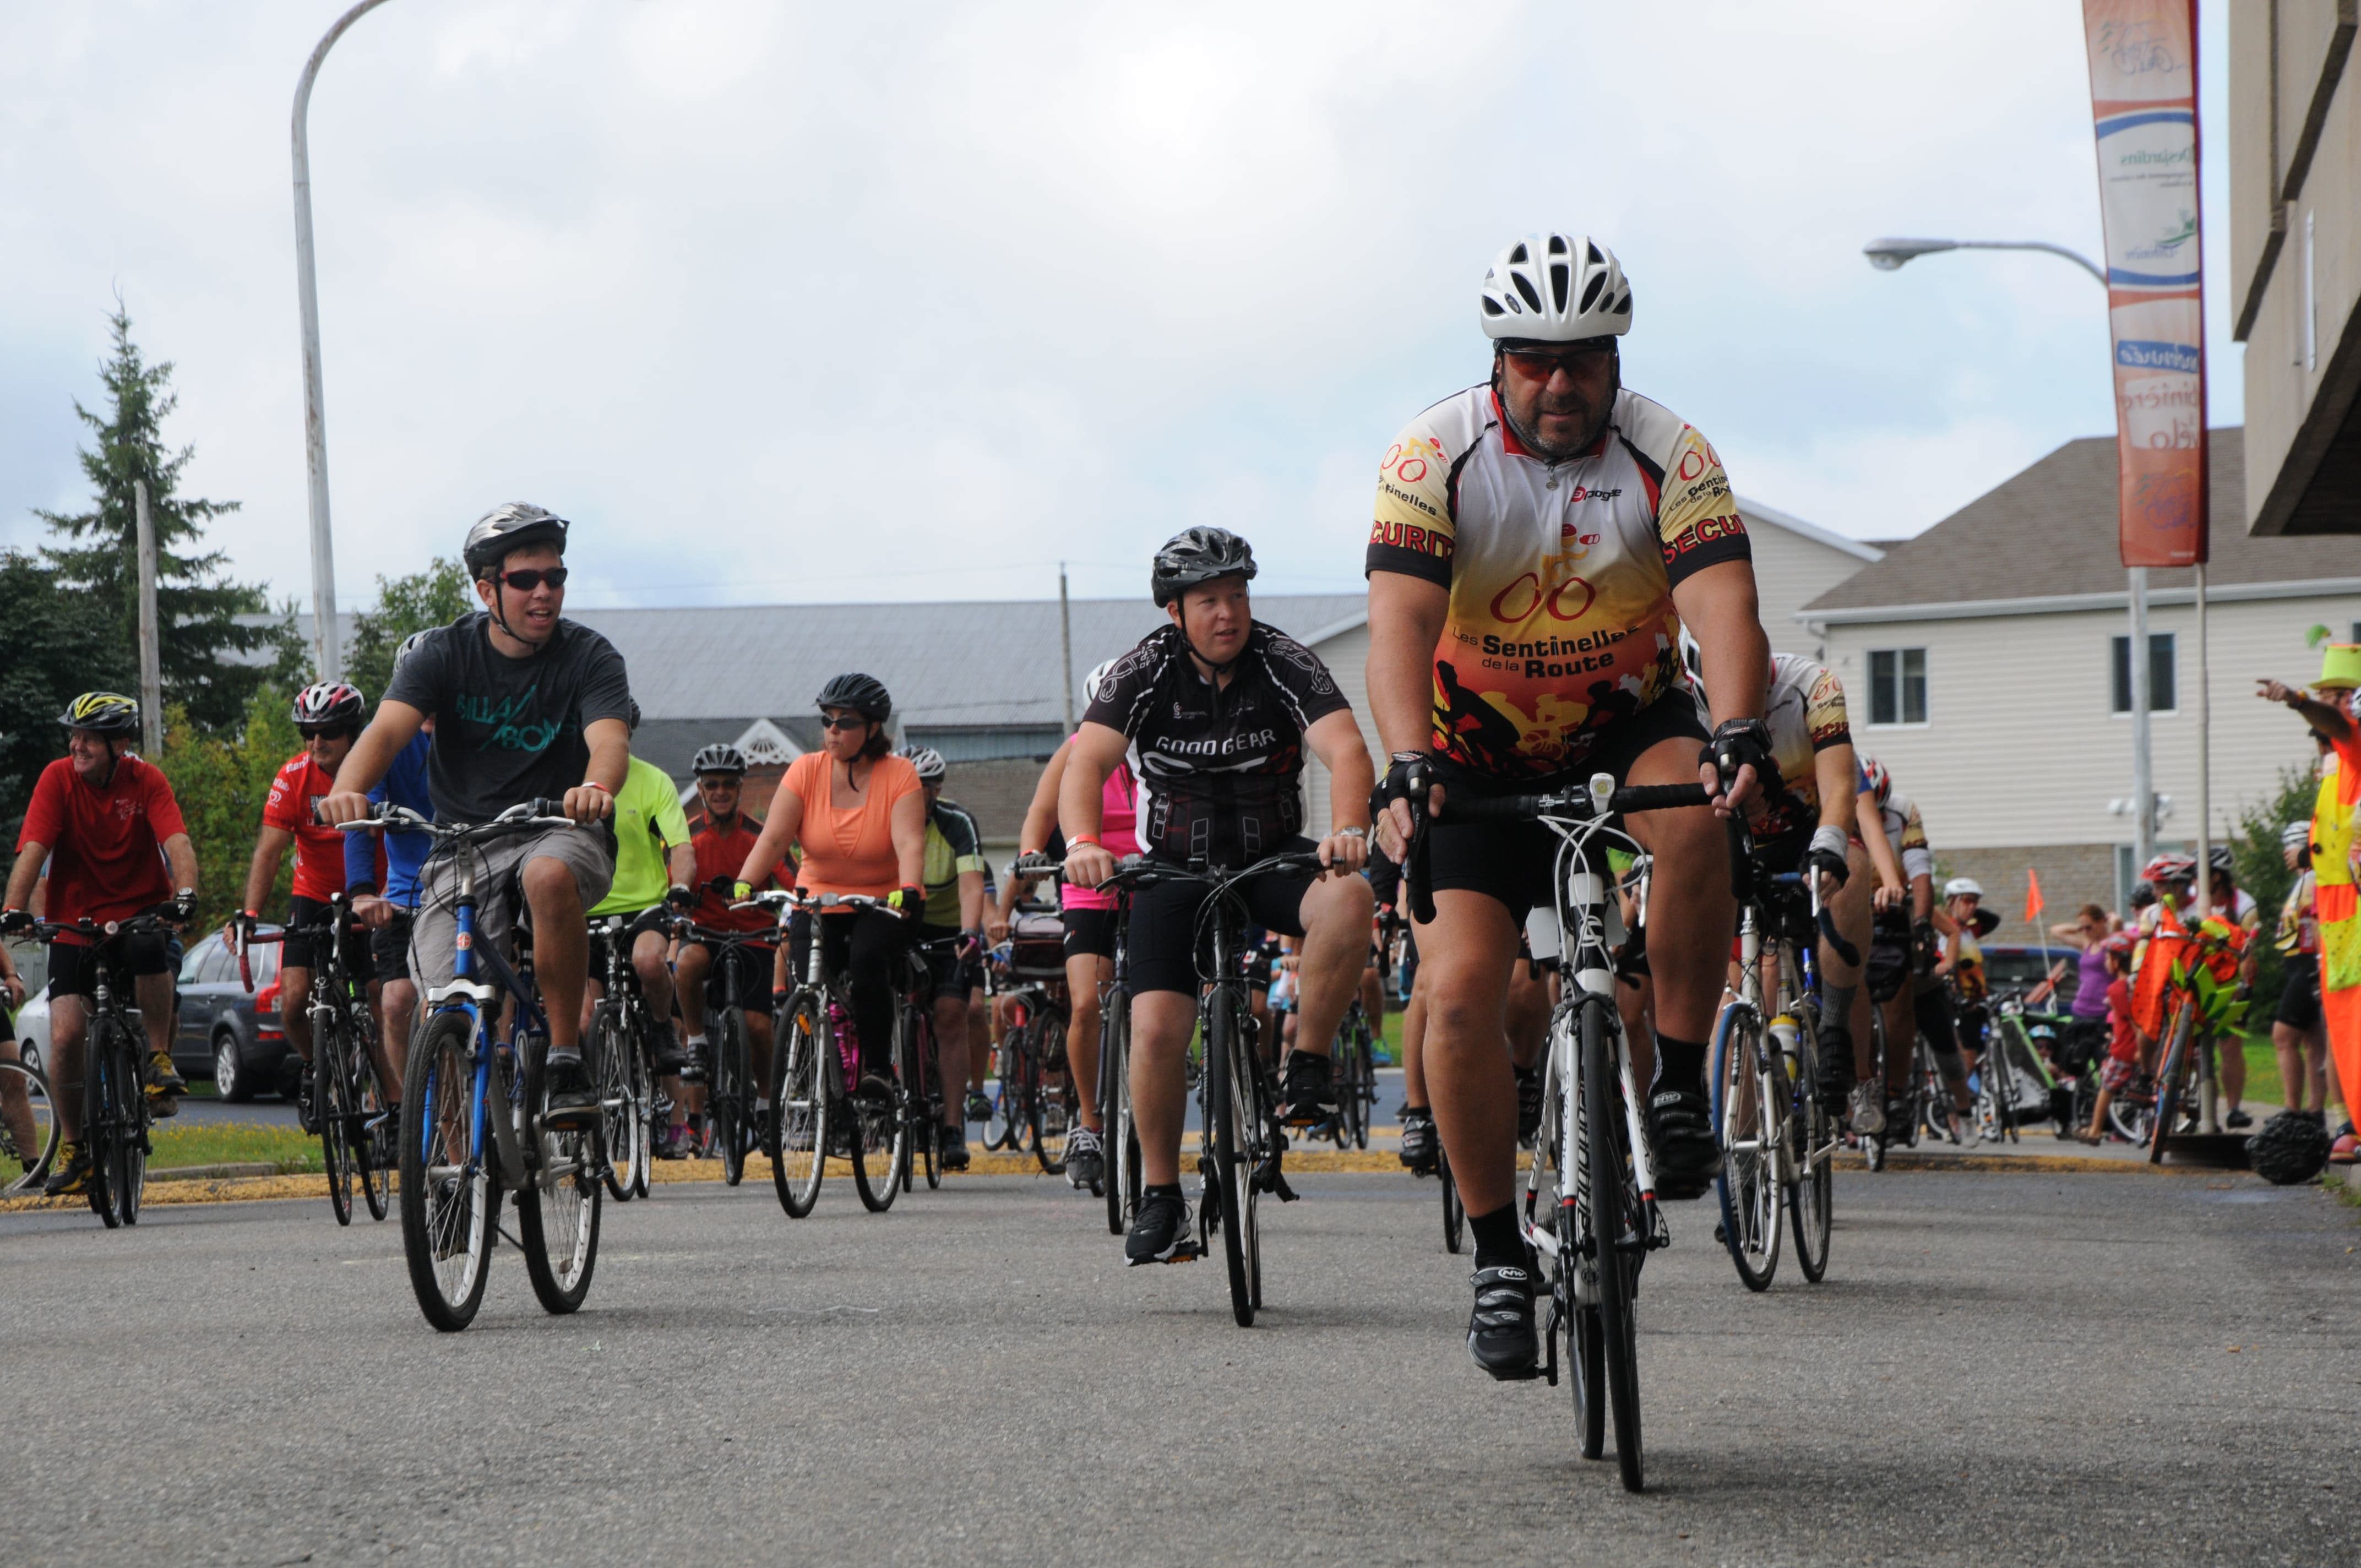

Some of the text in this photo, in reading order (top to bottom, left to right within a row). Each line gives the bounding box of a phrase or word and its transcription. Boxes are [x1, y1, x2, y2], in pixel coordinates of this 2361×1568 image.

[1452, 627, 1478, 646] Les
[1482, 652, 1614, 678] de la Route
